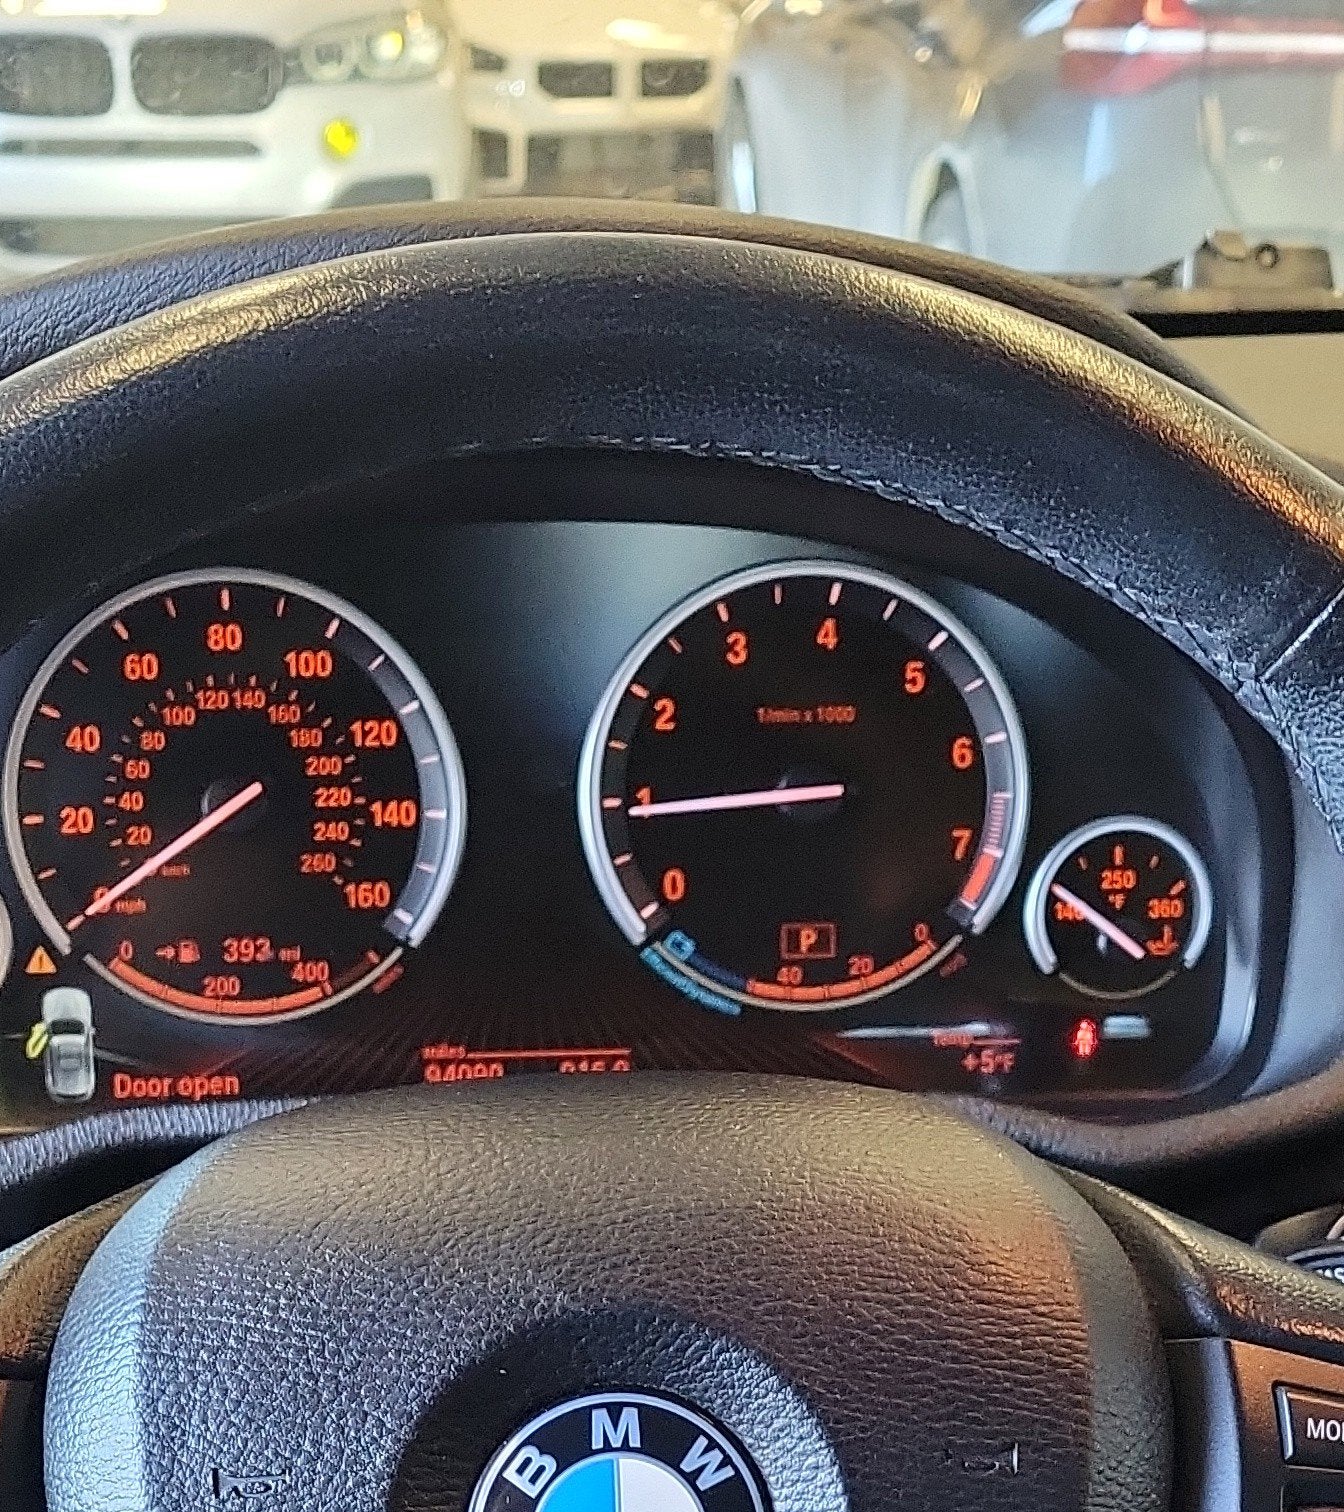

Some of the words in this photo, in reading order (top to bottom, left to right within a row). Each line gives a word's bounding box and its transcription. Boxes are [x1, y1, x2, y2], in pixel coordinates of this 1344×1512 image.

[207, 624, 242, 652] 80
[816, 618, 838, 650] 4
[726, 631, 748, 664] 3
[124, 653, 158, 681] 60
[285, 651, 332, 679] 100
[904, 660, 926, 694] 5
[196, 689, 229, 709] 120
[232, 689, 266, 709] 140
[163, 706, 195, 726] 100
[268, 704, 301, 724] 160
[655, 698, 677, 731] 2
[66, 725, 101, 752] 40
[140, 730, 166, 751] 80
[290, 728, 323, 748] 180
[350, 719, 398, 747] 120
[952, 736, 974, 769] 6
[125, 759, 150, 780] 60
[306, 755, 342, 776] 200
[117, 790, 144, 812] 40
[314, 787, 352, 808] 220
[635, 786, 652, 819] 1
[60, 806, 94, 835] 20
[370, 800, 417, 828] 140
[126, 826, 152, 846] 20
[313, 821, 349, 841] 240
[951, 829, 974, 861] 7
[299, 852, 337, 873] 260
[662, 867, 686, 902] 0
[1100, 868, 1137, 890] 250
[344, 880, 391, 909] 160
[1148, 898, 1184, 920] 360
[799, 926, 819, 953] P
[914, 922, 930, 943] 0
[119, 939, 133, 962] 0
[291, 961, 329, 982] 400
[776, 966, 803, 986] 40
[848, 955, 874, 975] 20
[204, 974, 241, 997] 200
[114, 1073, 173, 1098] Door
[178, 1075, 239, 1101] open
[502, 1406, 735, 1500] BMW
